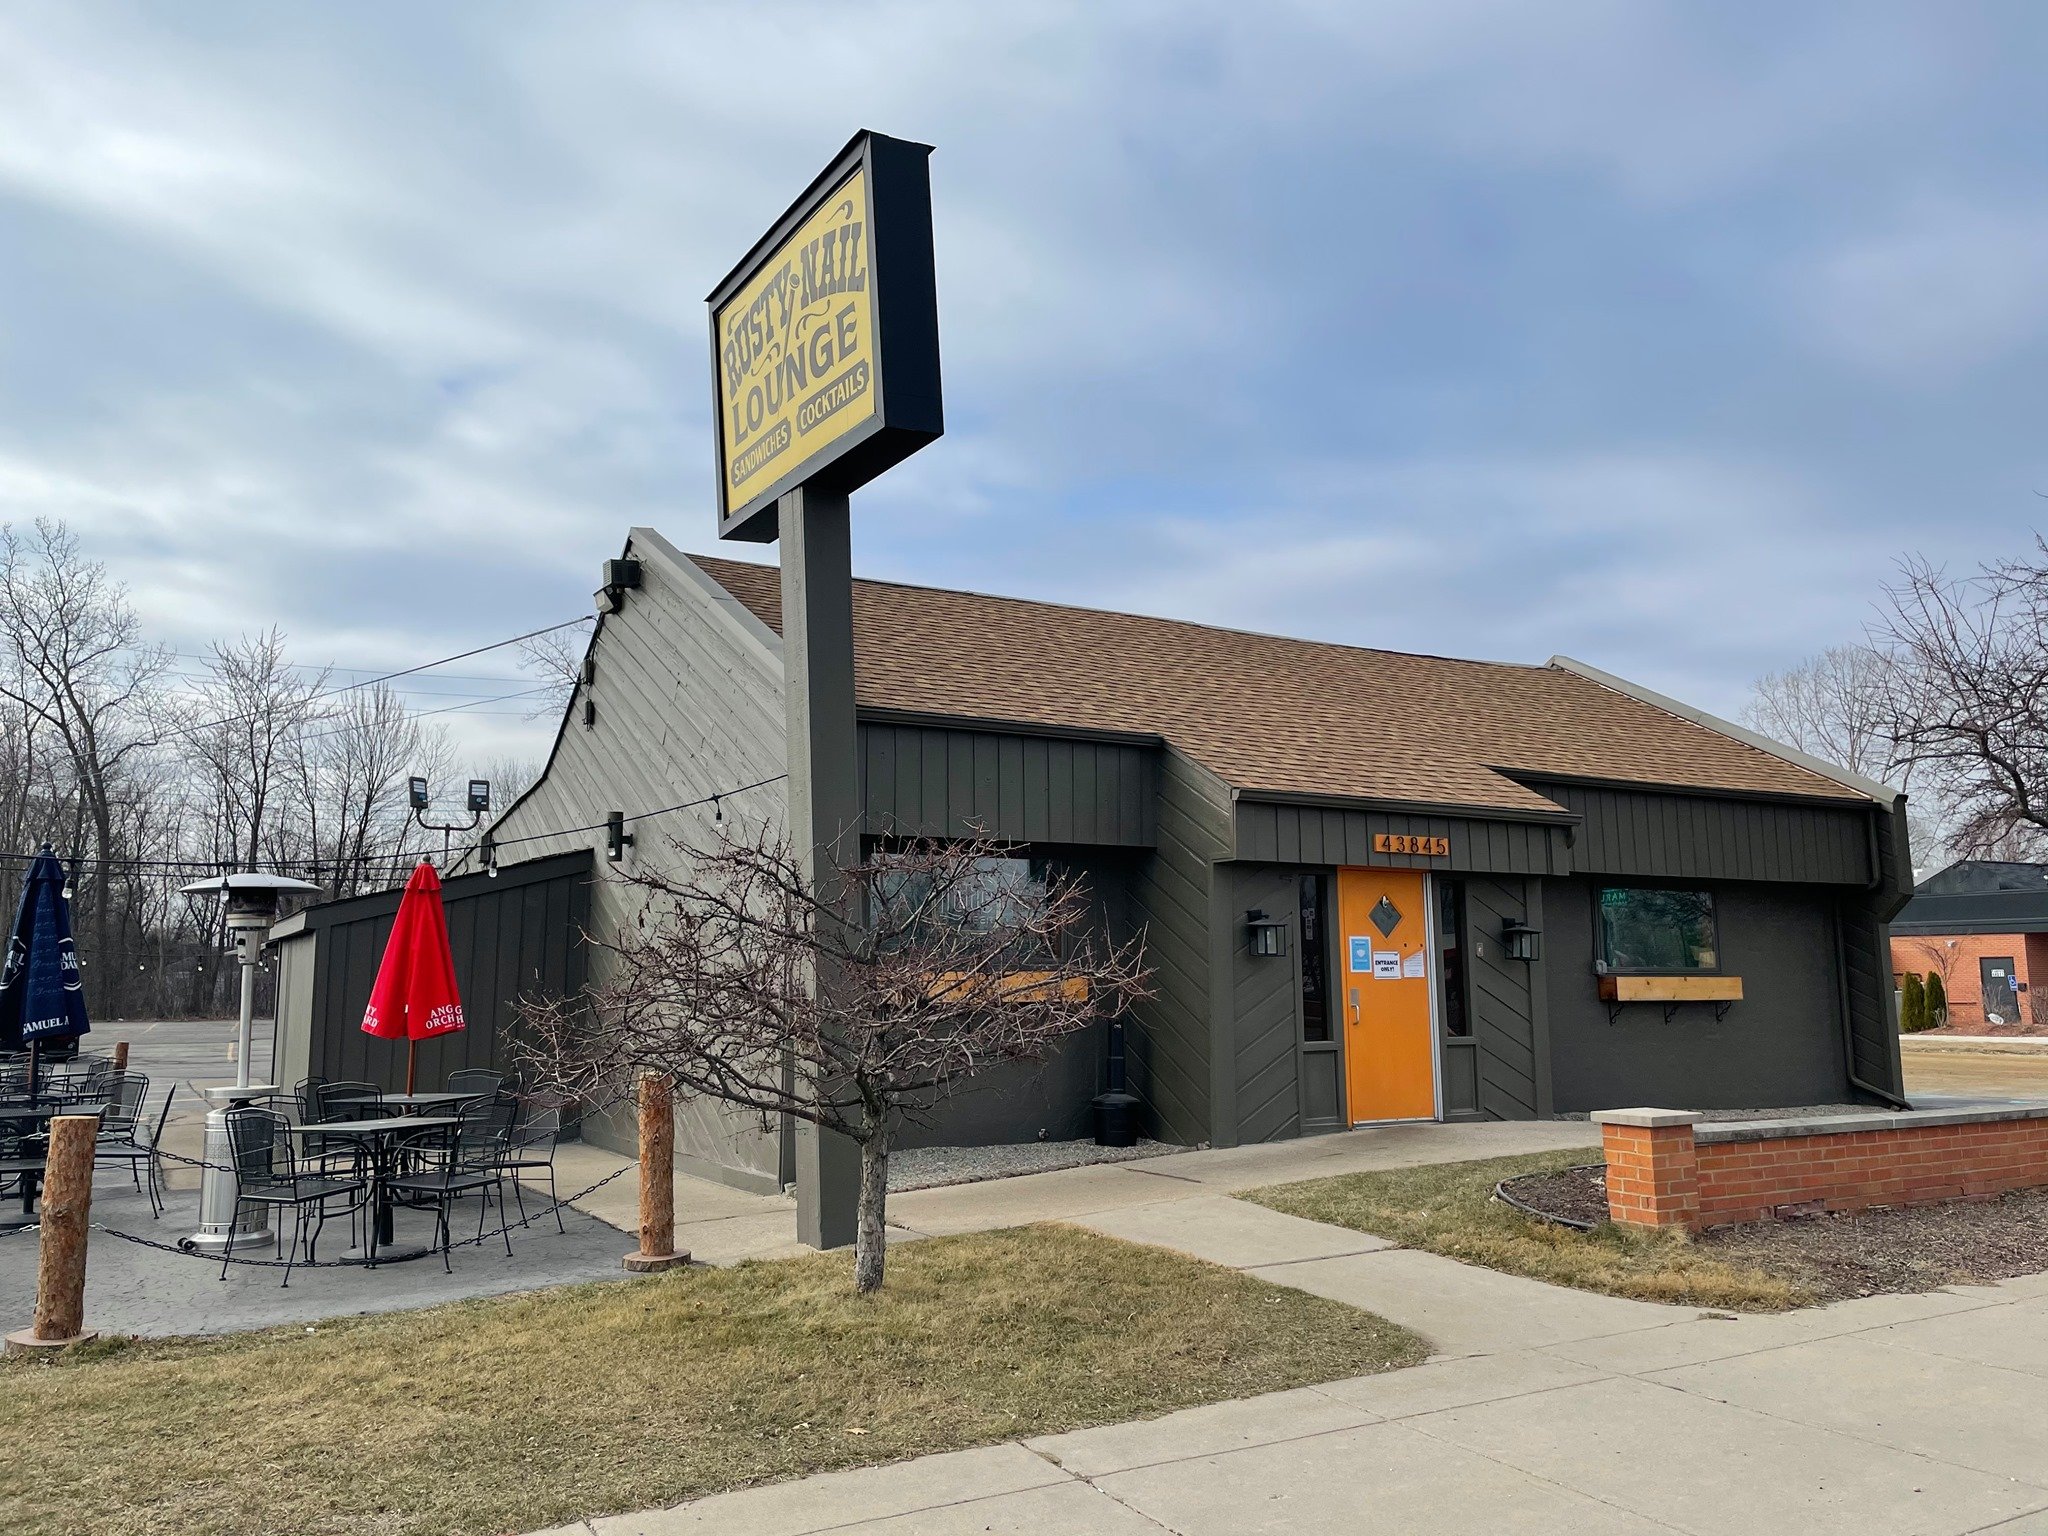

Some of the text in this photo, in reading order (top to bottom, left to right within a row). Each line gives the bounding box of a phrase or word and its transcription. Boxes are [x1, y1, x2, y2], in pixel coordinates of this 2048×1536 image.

[723, 221, 866, 401] RUSTY NAIL
[732, 301, 858, 447] LOUNGE
[799, 367, 865, 430] COCKTAILS
[734, 424, 788, 482] SANDWICHES
[1382, 835, 1446, 855] 43845
